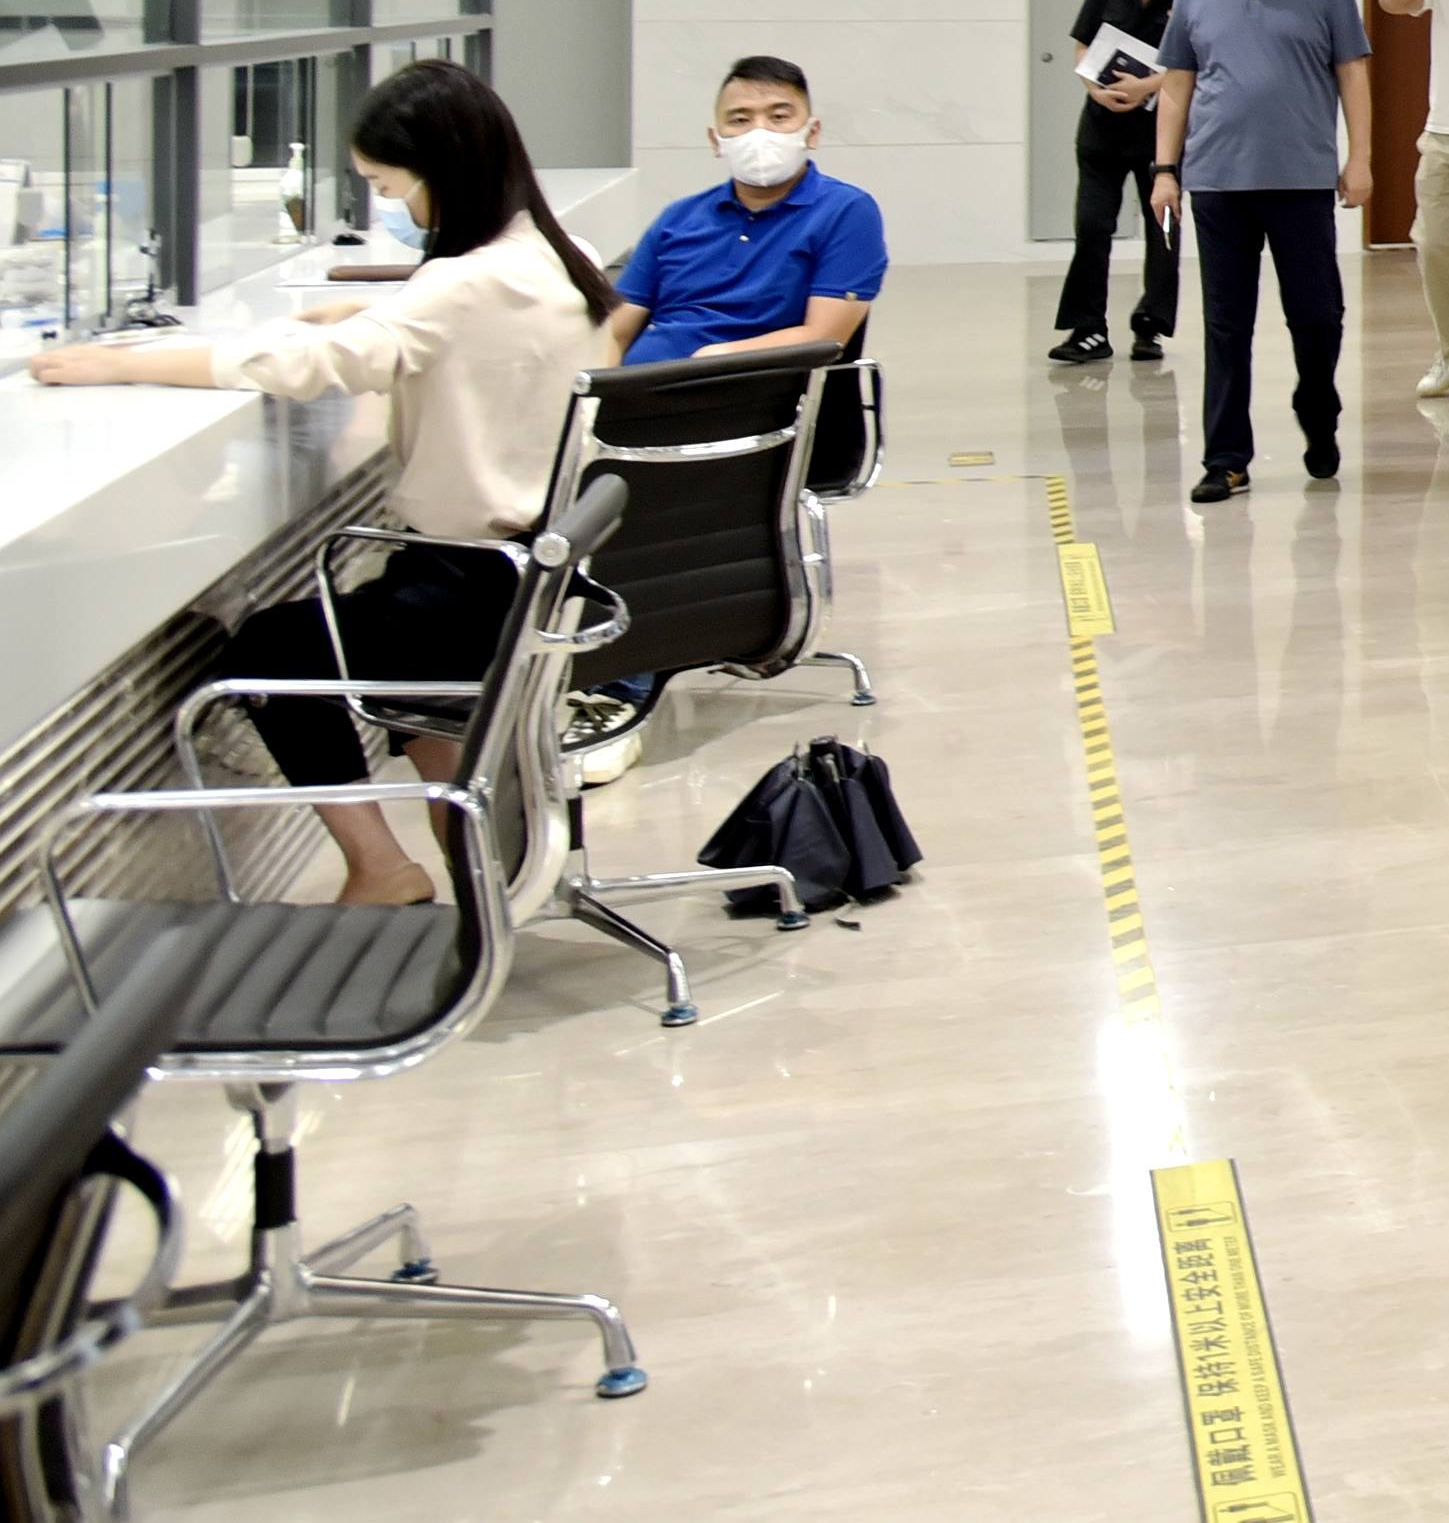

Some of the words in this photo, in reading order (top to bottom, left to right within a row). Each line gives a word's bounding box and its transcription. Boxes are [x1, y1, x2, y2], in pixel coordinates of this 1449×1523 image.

[1173, 1238, 1242, 1398] 保持1米以上安全距离
[1201, 1406, 1258, 1487] 佩戴口罩
